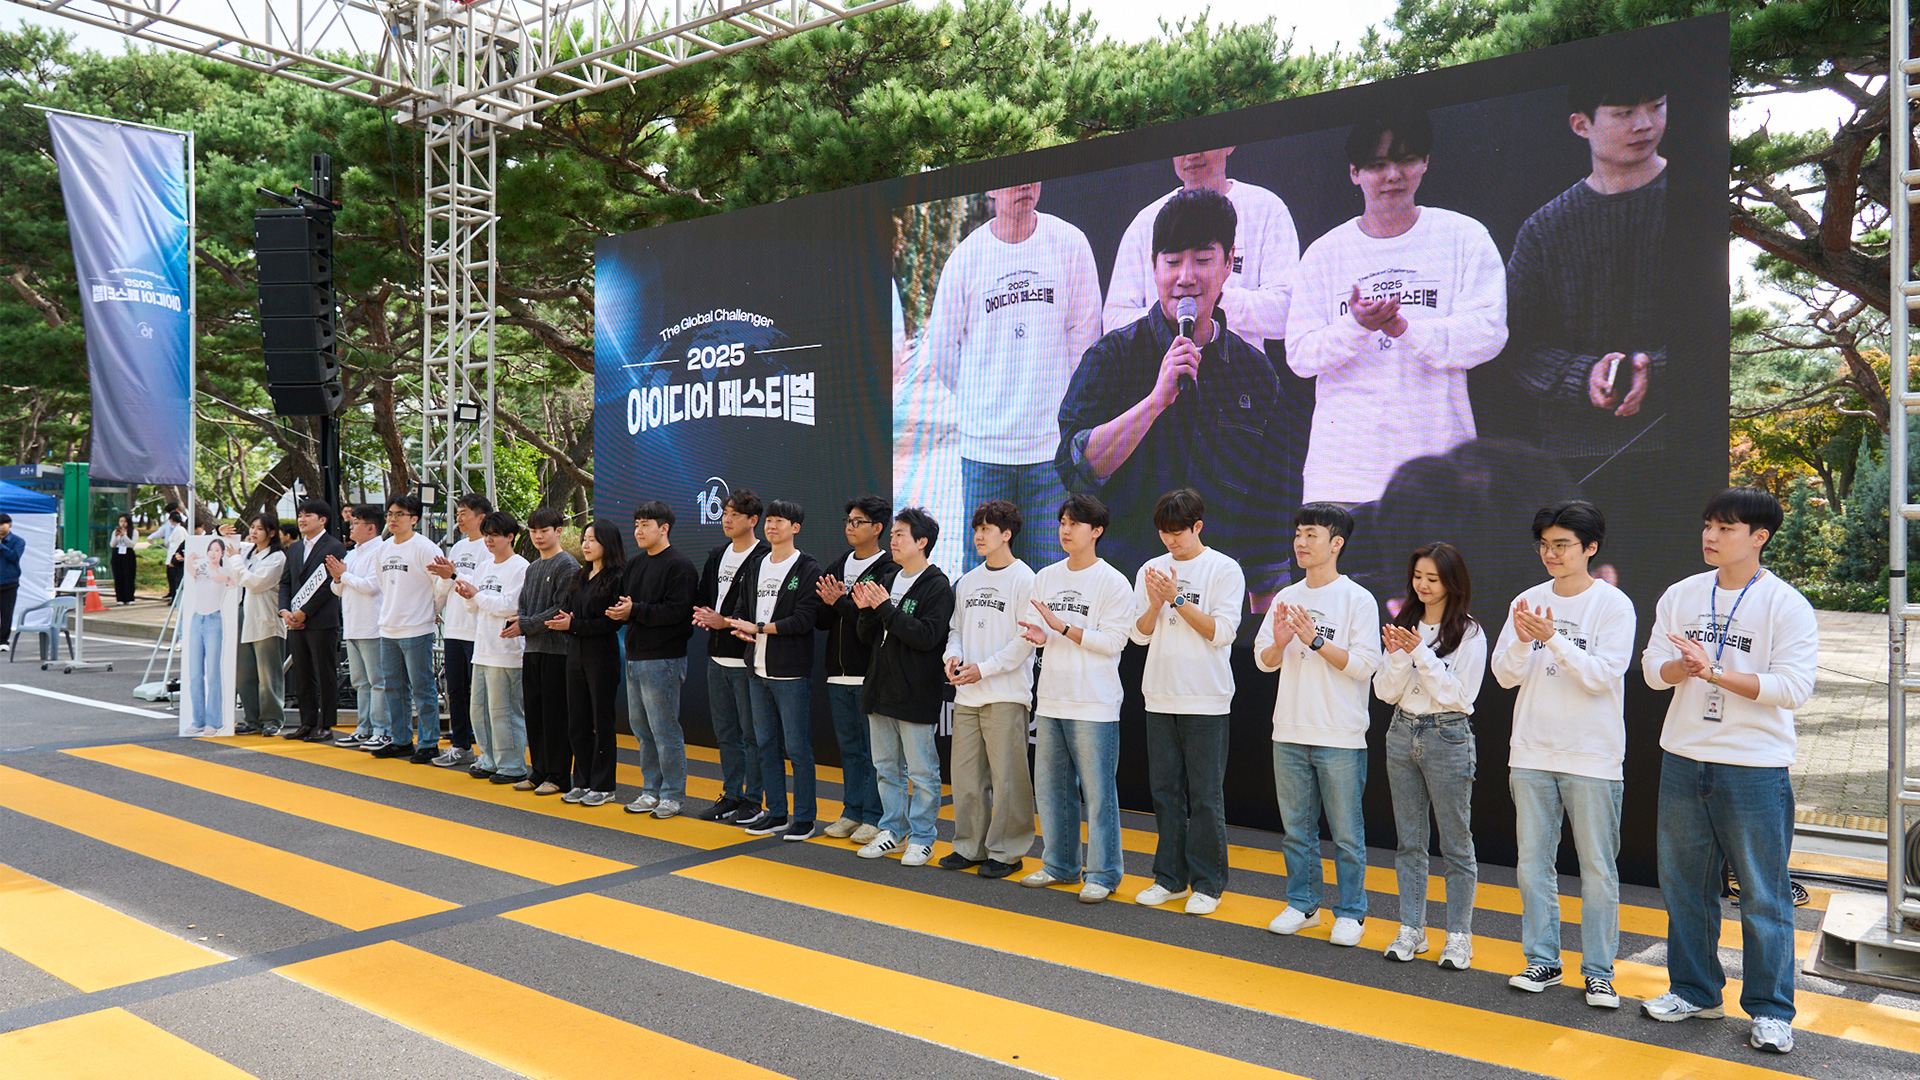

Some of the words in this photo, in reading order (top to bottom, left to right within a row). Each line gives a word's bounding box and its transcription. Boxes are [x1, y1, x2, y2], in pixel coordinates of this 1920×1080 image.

[1007, 279, 1030, 291] 2025
[1372, 279, 1403, 292] 2025
[985, 291, 1019, 314] 아이디어
[1020, 287, 1055, 305] 페스티벌
[659, 325, 681, 342] The
[680, 309, 713, 331] Global
[714, 308, 774, 328] Challenger
[687, 342, 746, 371] 2025
[627, 380, 713, 436] 아이디어
[718, 371, 816, 427] 페스티벌
[696, 485, 724, 525] 16
[1169, 617, 1177, 626] 16
[1546, 665, 1557, 677] 16
